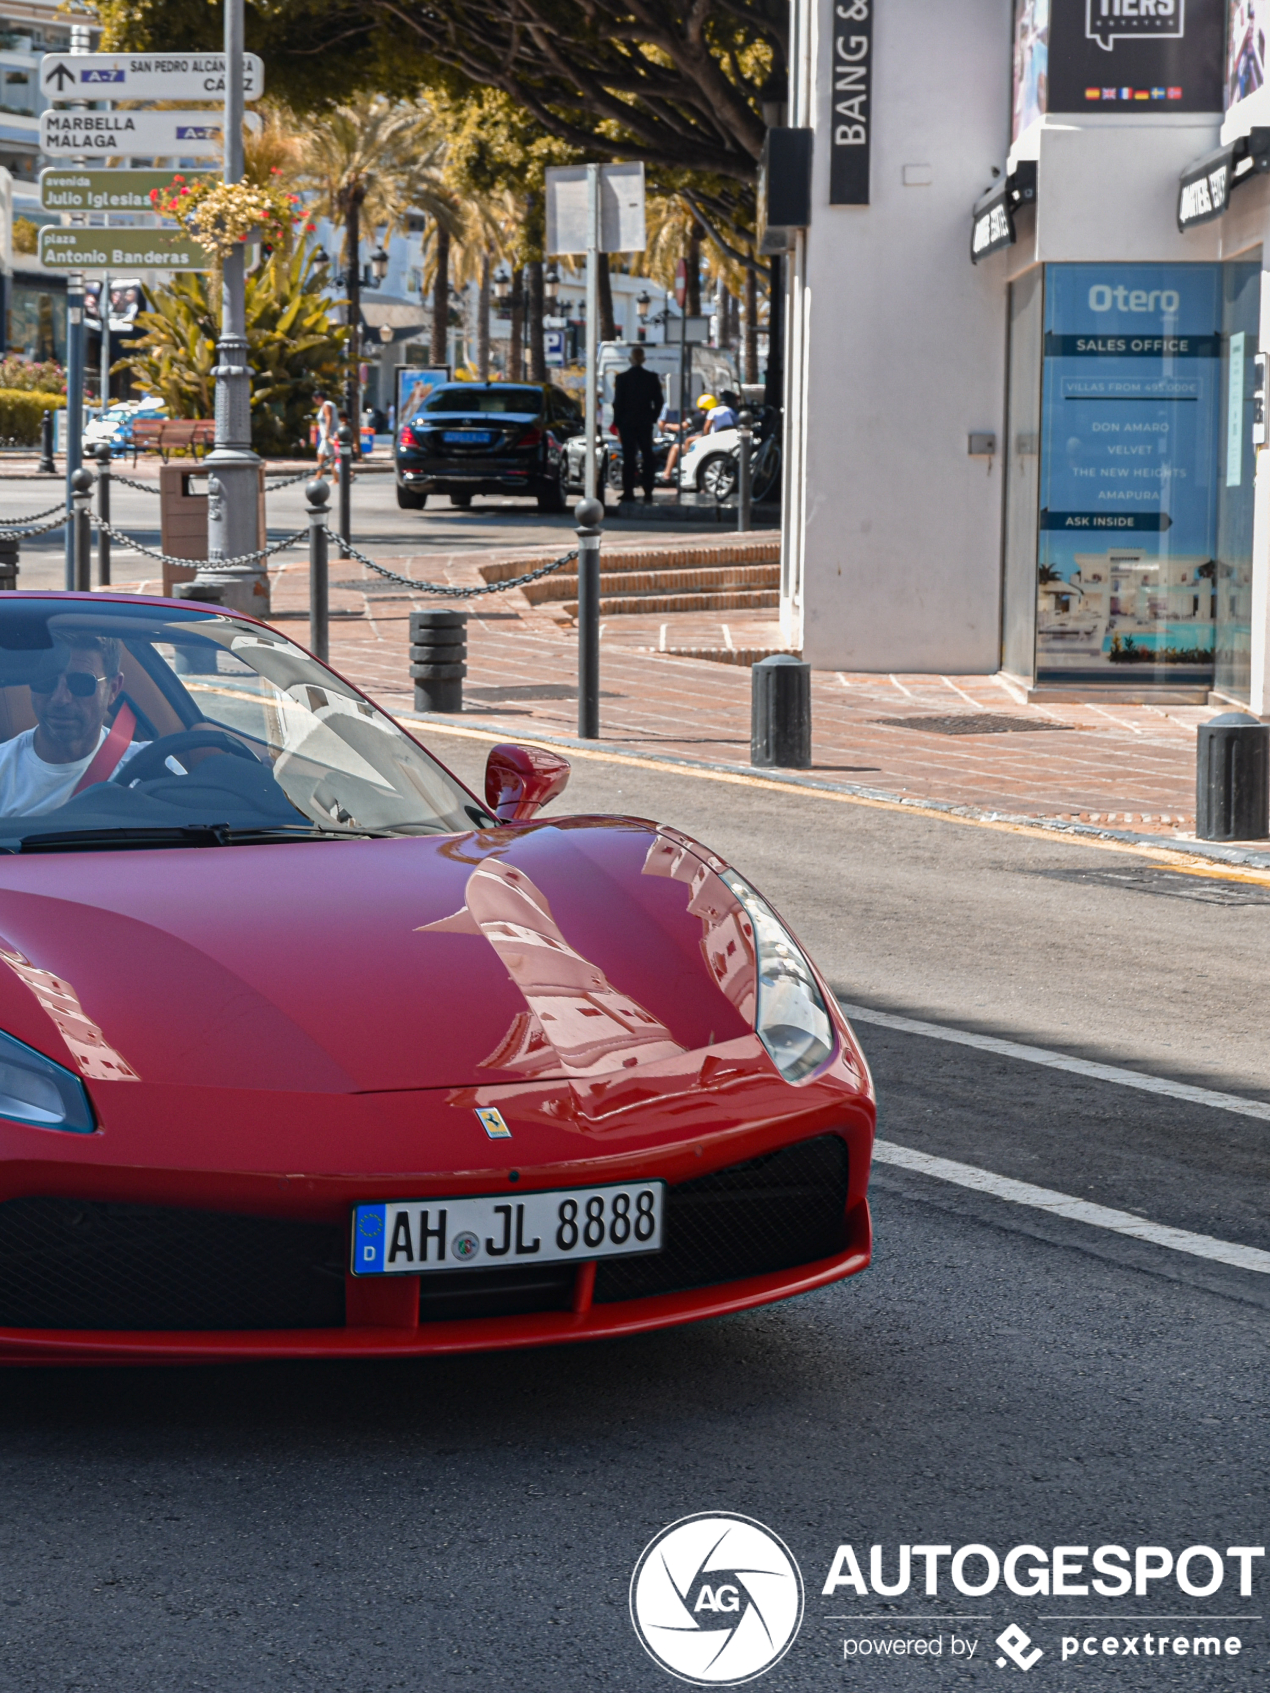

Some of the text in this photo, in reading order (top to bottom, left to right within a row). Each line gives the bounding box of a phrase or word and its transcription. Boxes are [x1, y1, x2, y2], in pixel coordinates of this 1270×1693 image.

[130, 60, 152, 72] SAN
[155, 60, 188, 72] PEDRO
[835, 0, 868, 145] BANG &
[88, 71, 118, 81] A-7
[204, 74, 253, 91] CÁZ
[47, 118, 136, 131] MARBELLA
[47, 131, 117, 147] MÁLAGA
[45, 176, 91, 187] avenida
[45, 191, 151, 208] Julio Iglesias
[44, 233, 76, 246] plaza
[45, 249, 189, 264] Antonio Banderas
[1088, 284, 1180, 312] Otero
[543, 333, 559, 352] P
[1077, 339, 1189, 351] SALES OFFICE
[1067, 383, 1105, 392] VILLAS
[1109, 383, 1141, 392] FROM
[1092, 423, 1169, 432] DON AMARO
[1108, 445, 1153, 454] VELVET
[1073, 468, 1187, 478] THE NEW HEIGHTS
[1098, 491, 1160, 500] AMAPURA
[1065, 517, 1134, 526] ASK INSIDE
[388, 1189, 655, 1263] AH JL 8888
[363, 1246, 375, 1261] D
